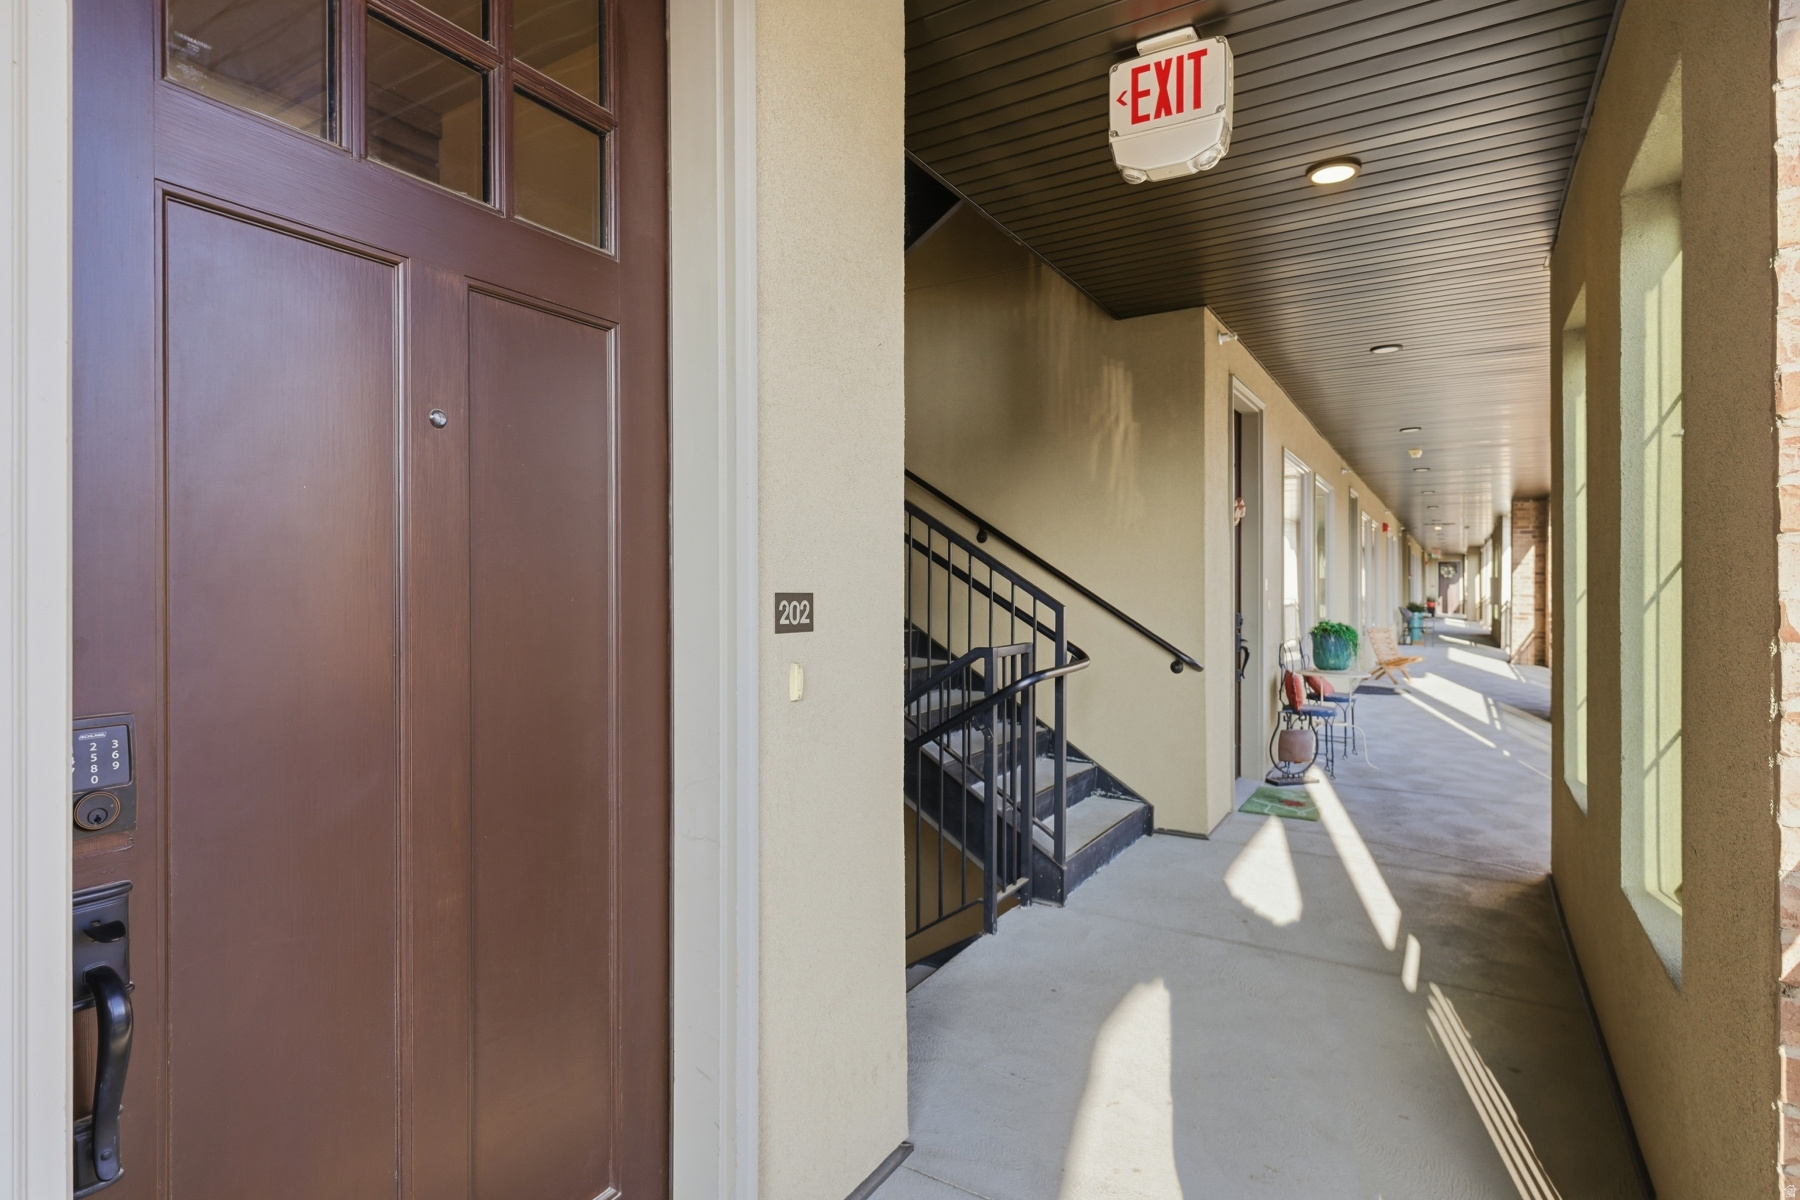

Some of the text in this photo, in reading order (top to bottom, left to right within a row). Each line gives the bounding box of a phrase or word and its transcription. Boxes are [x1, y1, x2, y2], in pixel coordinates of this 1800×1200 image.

[1131, 48, 1208, 125] EXIT
[779, 600, 810, 625] 202
[89, 739, 119, 752] 2 3
[90, 750, 120, 762] 5 6
[90, 761, 120, 773] 8 9
[90, 775, 99, 784] 0
